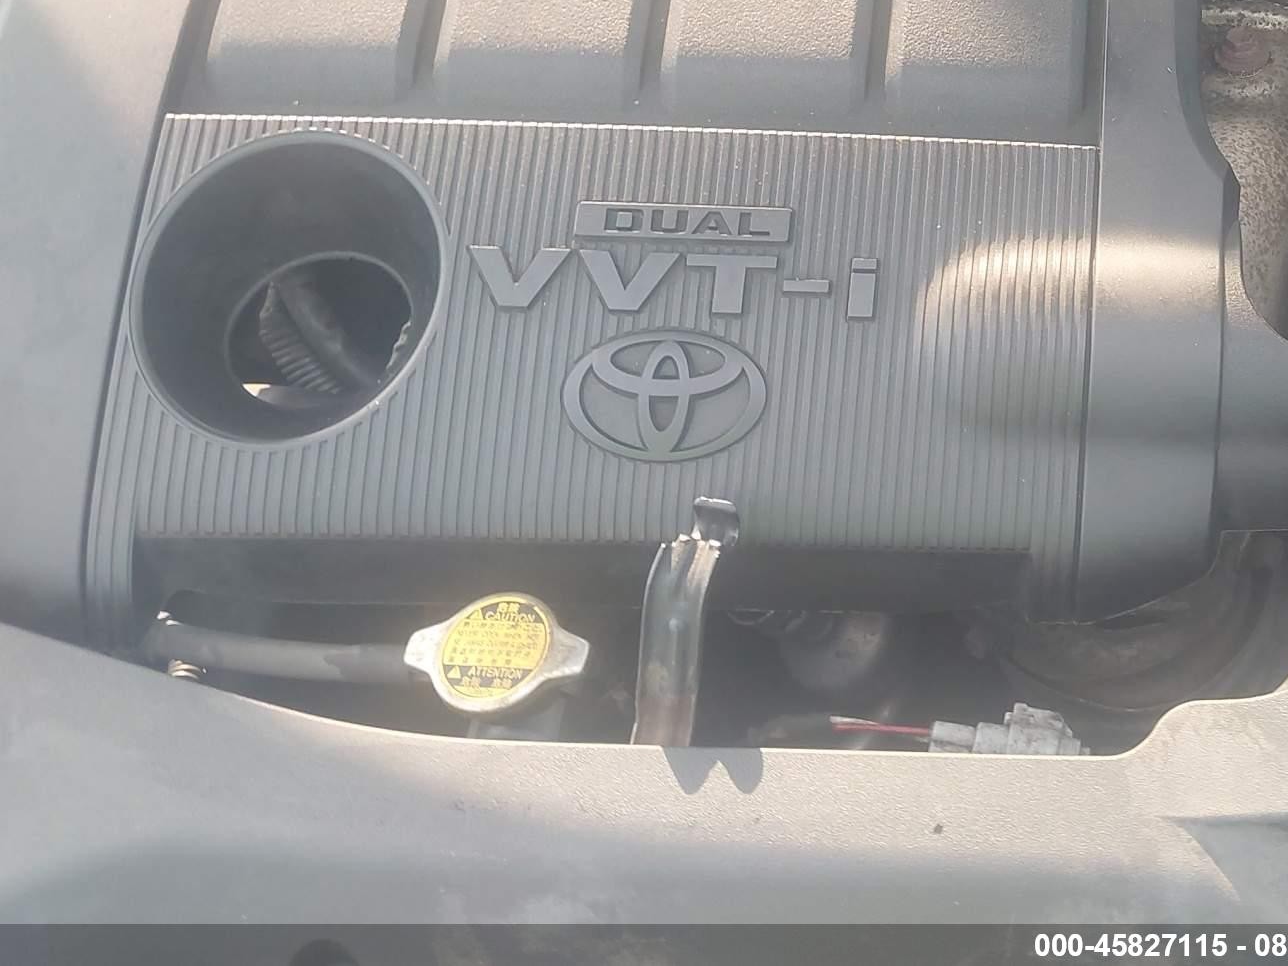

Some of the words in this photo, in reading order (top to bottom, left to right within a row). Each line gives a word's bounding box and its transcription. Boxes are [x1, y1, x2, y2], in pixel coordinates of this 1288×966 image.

[603, 207, 771, 237] DUAL
[467, 244, 879, 321] VVT-i
[484, 610, 536, 625] CAUTION
[467, 665, 523, 680] ATTENTION
